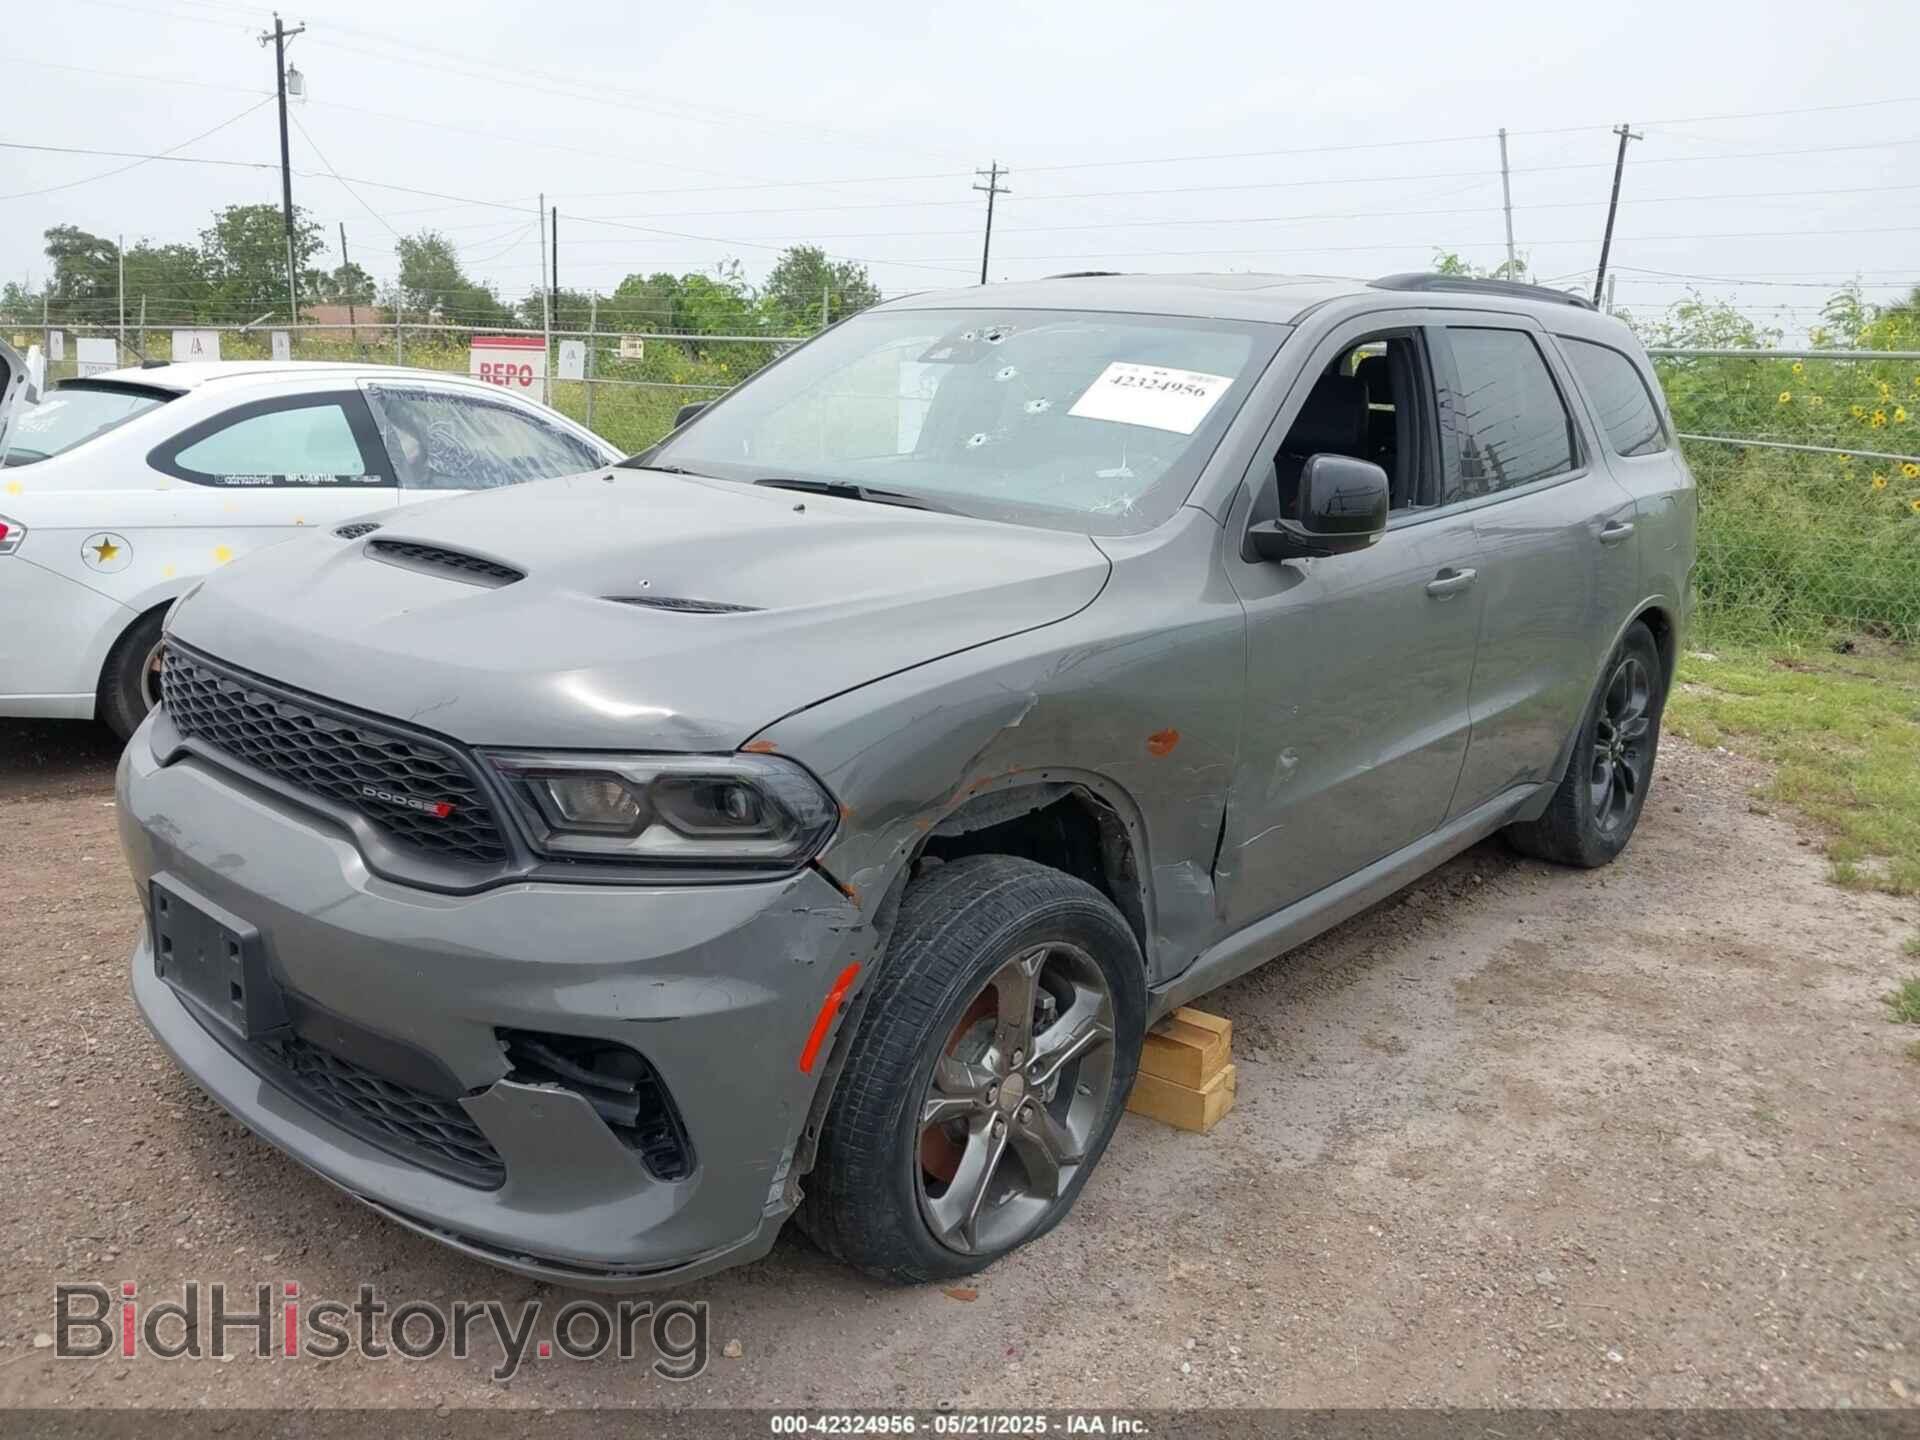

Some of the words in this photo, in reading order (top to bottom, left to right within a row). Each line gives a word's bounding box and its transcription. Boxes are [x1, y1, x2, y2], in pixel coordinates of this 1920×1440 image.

[480, 362, 533, 387] REPO
[1109, 375, 1206, 397] 42324956
[362, 786, 440, 814] DODGE
